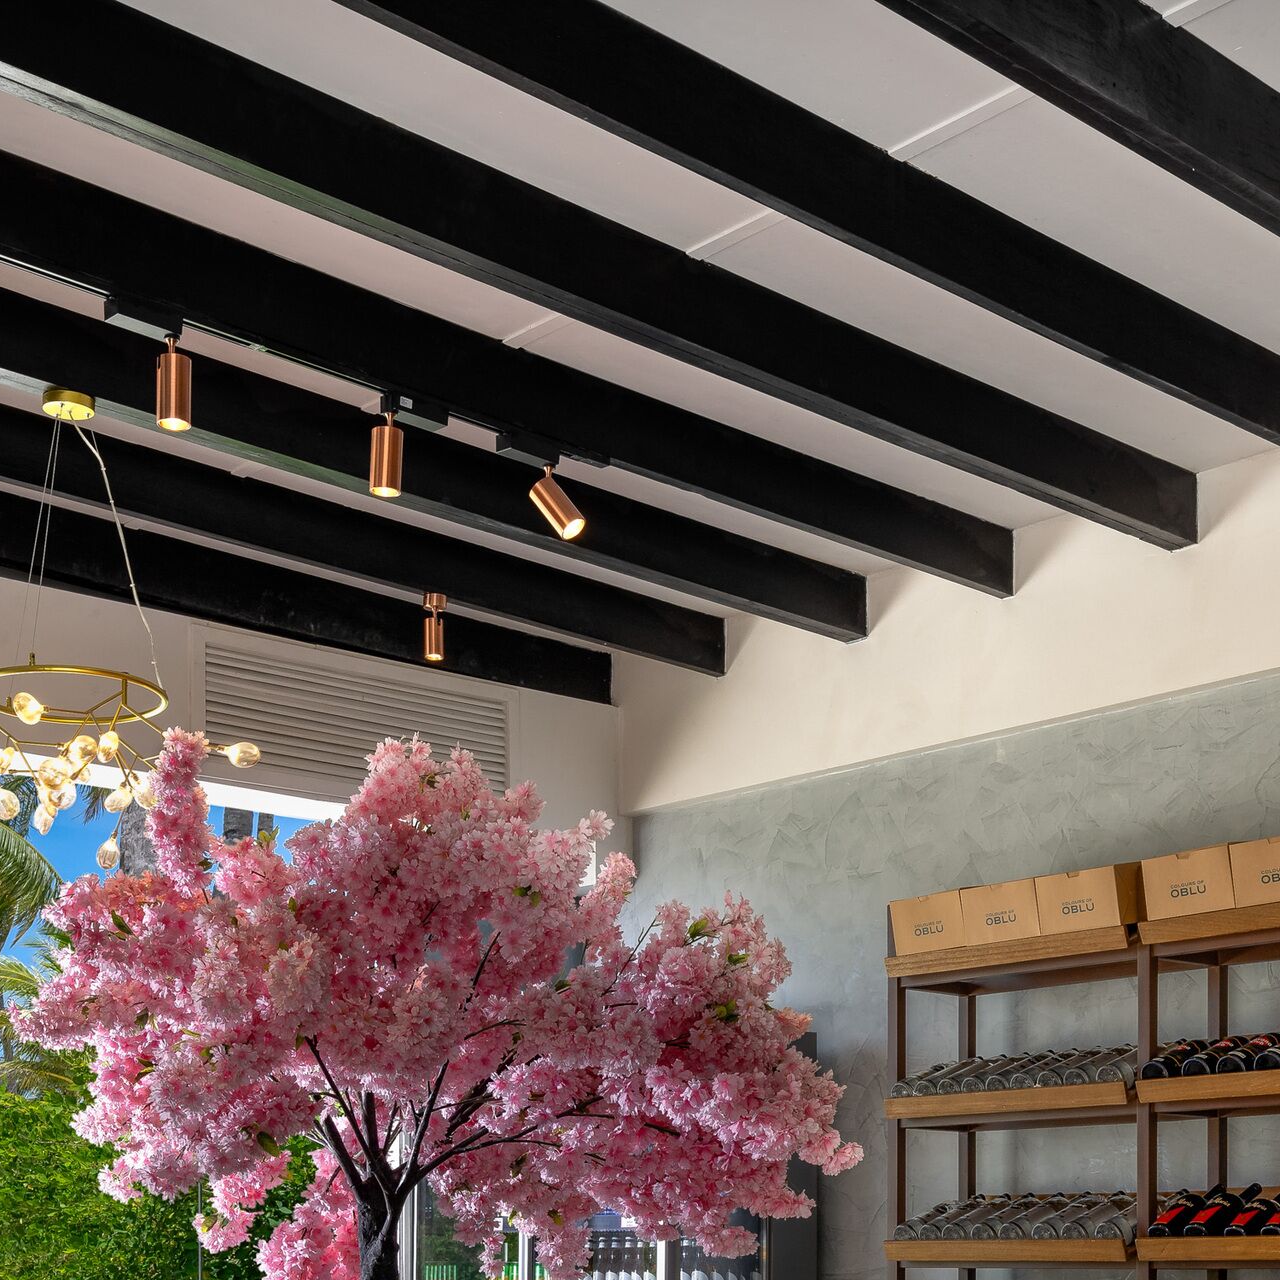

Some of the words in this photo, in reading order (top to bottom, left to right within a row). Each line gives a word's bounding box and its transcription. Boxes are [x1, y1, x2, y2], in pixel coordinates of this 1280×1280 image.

[1170, 884, 1207, 898] OBLU
[1062, 902, 1095, 915] OBLU
[985, 913, 1016, 926] OBLU
[914, 924, 944, 936] OBLU
